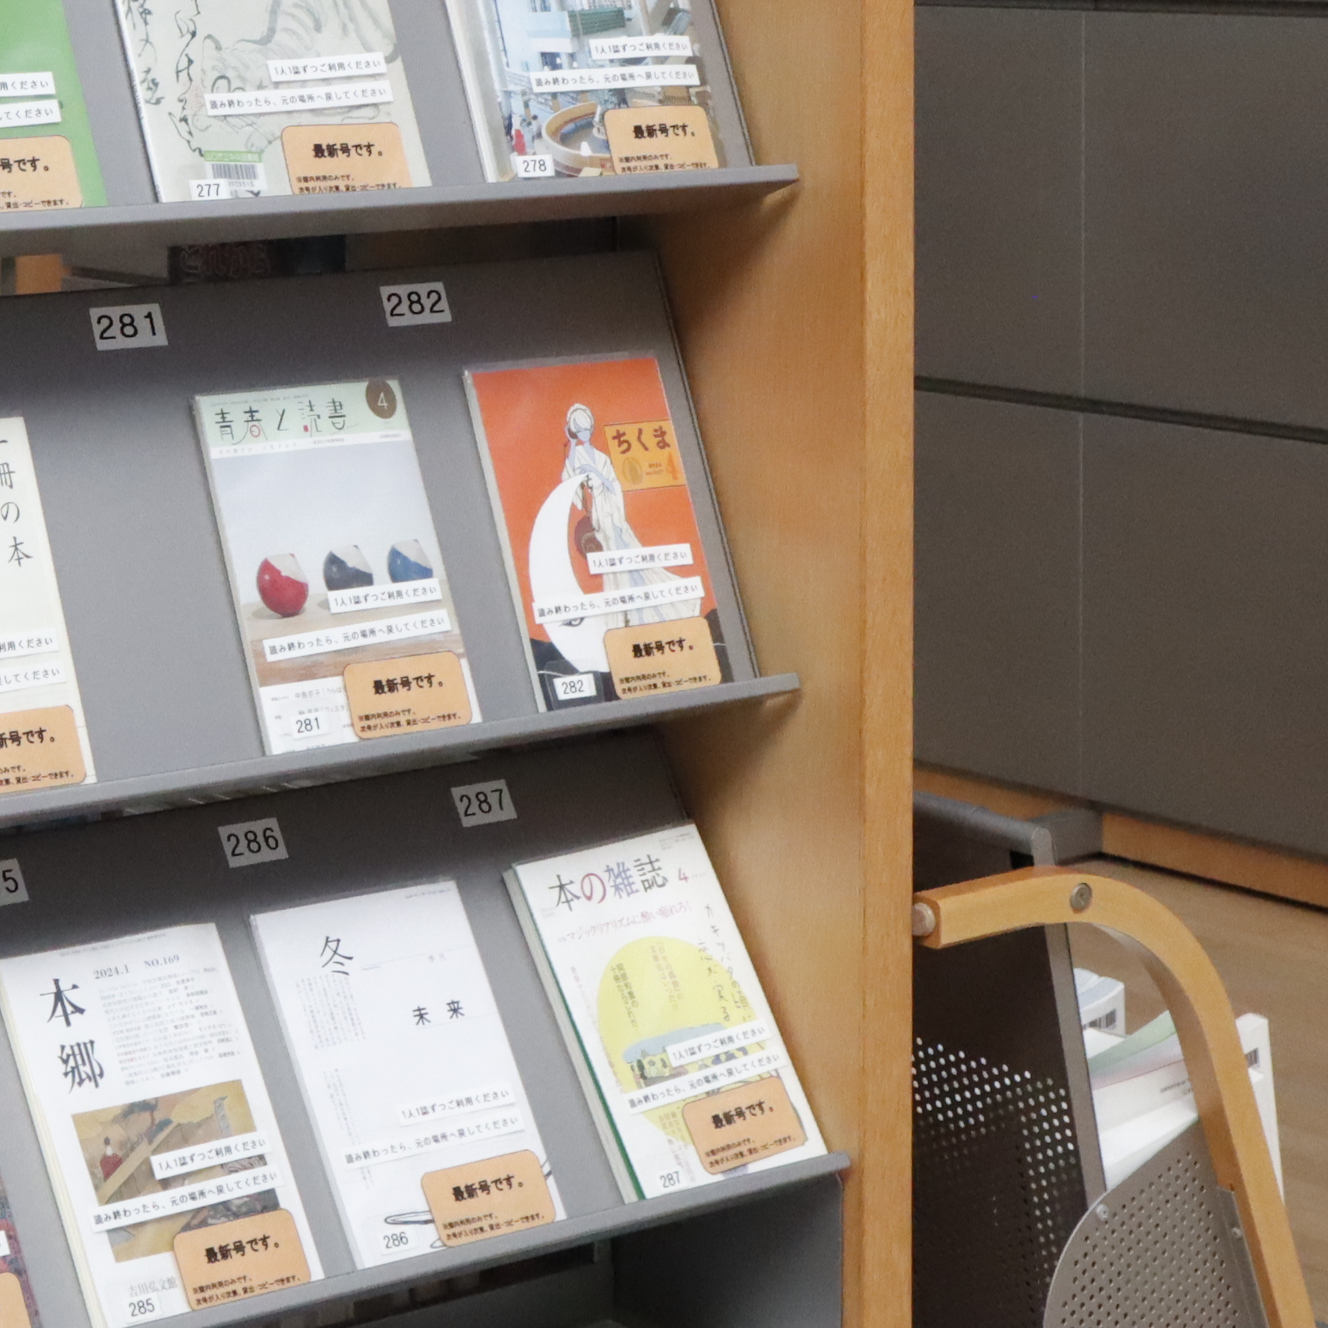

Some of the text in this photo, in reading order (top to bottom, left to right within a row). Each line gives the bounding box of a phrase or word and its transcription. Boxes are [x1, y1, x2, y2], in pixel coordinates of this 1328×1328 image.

[595, 43, 688, 54] 1人1誌ずつご利用ください
[274, 61, 382, 76] 1人1誌ずつご利用ください
[535, 71, 695, 88] 読み終わったら、元の場所へ戻してください
[210, 88, 388, 110] 読み終わったら、元の場所へ戻してください
[633, 124, 696, 139] 最新号です。
[312, 143, 384, 159] 最新号です。
[523, 160, 546, 172] 278
[196, 183, 220, 198] 277
[387, 290, 445, 317] 282
[96, 312, 157, 340] 281
[377, 392, 389, 410] 4
[612, 426, 671, 454] ちくま
[592, 551, 688, 568] 1人1誌ずつご利用ください
[334, 586, 438, 607] 1人1誌ずつご利用ください
[538, 583, 699, 618] 読み終わったら、元の場所へ戻してください
[269, 617, 445, 655] 読み終わったら、元の場所へ戻してください
[632, 637, 694, 659] 最新号です。
[373, 673, 444, 696] 最新号です。
[562, 680, 584, 695] 282
[296, 717, 320, 734] 281
[459, 788, 504, 817] 287
[227, 827, 280, 857] 286
[549, 854, 689, 912] 本の雑誌 4
[144, 954, 180, 969] NO.169
[320, 935, 354, 976] 冬
[412, 999, 465, 1026] 未来
[40, 978, 104, 1094] 本郷
[673, 1026, 766, 1061] 1人1誌ずつご利用ください
[628, 1053, 781, 1110] 読み終わったら、元の場所へ戻してください
[402, 1089, 509, 1119] 1人1誌ずつご利用ください
[711, 1101, 775, 1130] 最新号です。
[345, 1116, 519, 1164] 読み終わったら、元の場所へ戻してください
[158, 1139, 267, 1171] 1人1誌ずつご利用ください
[452, 1174, 524, 1203] 最新号です。
[660, 1170, 681, 1188] 287
[93, 1172, 277, 1225] 読み終わったら、元の場所へ戻してください
[205, 1235, 280, 1264] 最新号です。
[383, 1232, 409, 1249] 286
[128, 1298, 156, 1317] 285
